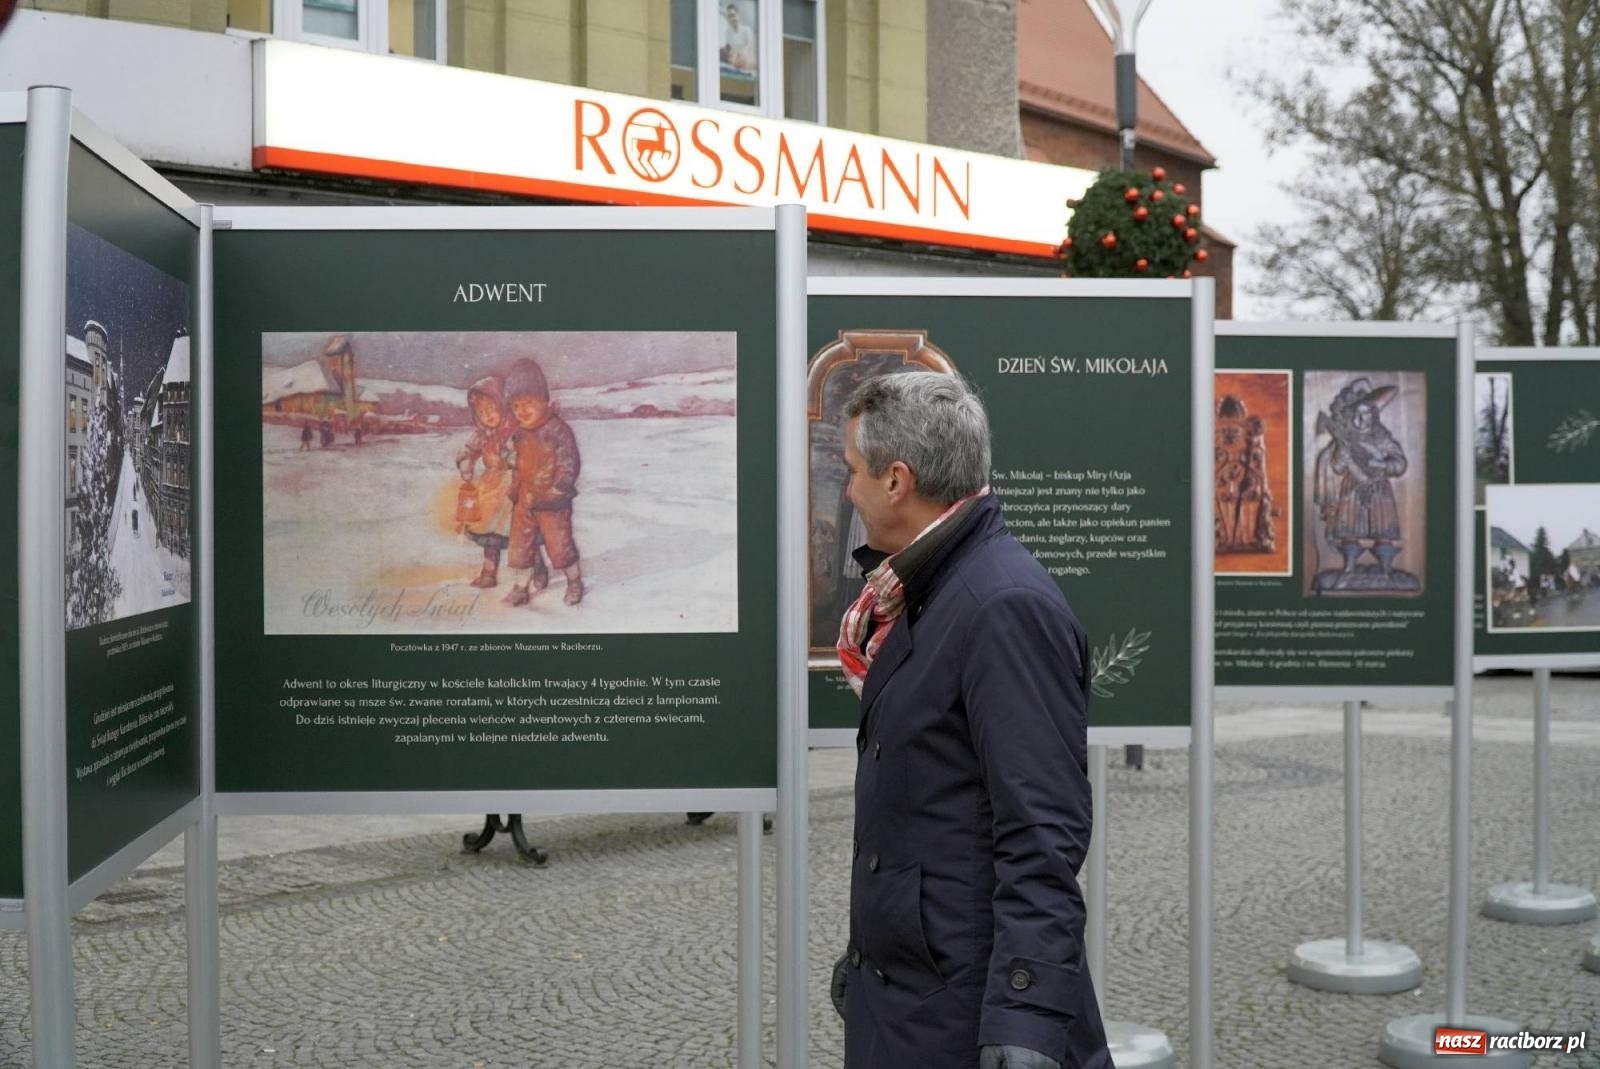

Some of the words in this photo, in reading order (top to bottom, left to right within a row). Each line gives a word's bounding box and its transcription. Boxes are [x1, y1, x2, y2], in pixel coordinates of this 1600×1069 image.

[575, 99, 970, 221] ROSSMANN
[453, 283, 547, 302] ADWENT
[998, 356, 1046, 374] DZIEŃ
[1050, 356, 1080, 374] ŚW.
[1085, 358, 1168, 376] MIKOŁAJA
[991, 469, 1008, 481] Św.
[1053, 469, 1086, 482] biskup
[1086, 469, 1108, 482] Miry
[1108, 469, 1133, 482] (Azja
[1036, 486, 1054, 497] jest
[1054, 487, 1083, 498] znany
[1084, 487, 1101, 496] nie
[1100, 485, 1125, 498] tylko
[1126, 485, 1147, 497] jako
[1052, 503, 1110, 514] przynoszący
[1110, 501, 1132, 514] dary
[1036, 517, 1052, 528] ale
[1052, 517, 1078, 528] także
[1079, 517, 1100, 529] jako
[1099, 516, 1138, 529] opiekun
[1139, 517, 1172, 529] panien
[1089, 532, 1126, 545] kupców
[1126, 534, 1149, 543] oraz
[1032, 548, 1085, 562] domowych,
[1085, 548, 1118, 561] przede
[1119, 548, 1167, 561] wszystkim
[1047, 565, 1092, 579] rogatego.
[390, 642, 433, 652] Pocztówka
[441, 642, 460, 652] 1947
[468, 644, 479, 652] ze
[479, 642, 513, 652] zbiorów
[514, 642, 550, 652] Muzeum
[560, 641, 604, 651] Raciborzu.
[282, 678, 323, 689] Adwent
[325, 679, 337, 689] to
[339, 678, 369, 689] okres
[371, 678, 427, 692] liturgiczny
[429, 680, 439, 689] w
[441, 677, 486, 689] kościele
[487, 677, 542, 689] katolickim
[590, 677, 597, 688] 4
[599, 676, 649, 691] tygodnie.
[651, 675, 663, 687] W
[664, 677, 686, 690] tym
[687, 676, 721, 687] czasie
[279, 696, 342, 709] odprawiane
[343, 699, 356, 708] są
[358, 699, 387, 707] msze
[388, 697, 407, 707] św.
[408, 698, 443, 707] zwane
[445, 696, 493, 707] roratami,
[494, 698, 505, 706] w
[506, 695, 547, 709] których
[549, 695, 611, 707] uczestniczą
[612, 694, 645, 706] dzieci
[646, 697, 654, 706] z
[656, 694, 721, 708] lampionami.
[295, 714, 311, 725] Do
[313, 714, 335, 725] dziś
[338, 715, 377, 727] istnieje
[378, 715, 420, 728] zwyczaj
[422, 714, 467, 728] plecenia
[469, 714, 516, 725] wieńców
[519, 713, 592, 727] adwentowych
[593, 715, 601, 724] z
[603, 713, 652, 724] czterema
[653, 713, 706, 724] świecami,
[394, 732, 455, 745] zapalanymi
[457, 734, 467, 742] w
[469, 731, 509, 744] kolejne
[510, 731, 559, 742] niedziele
[560, 731, 609, 742] adwentu.
